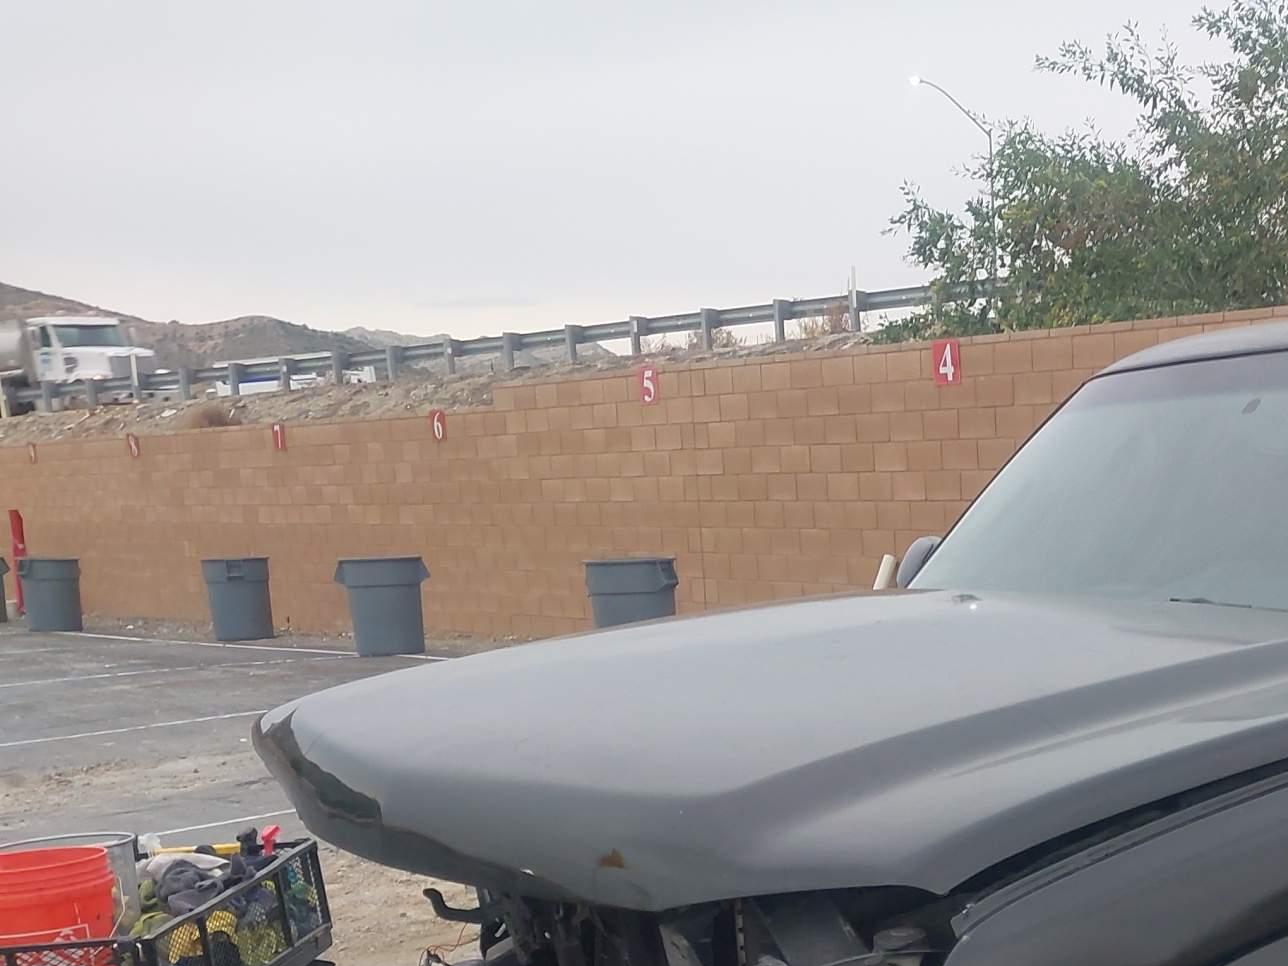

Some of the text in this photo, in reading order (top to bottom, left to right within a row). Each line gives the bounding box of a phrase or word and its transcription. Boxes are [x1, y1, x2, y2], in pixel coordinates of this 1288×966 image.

[939, 343, 954, 382] 4
[643, 370, 655, 402] 5
[434, 412, 443, 440] 6
